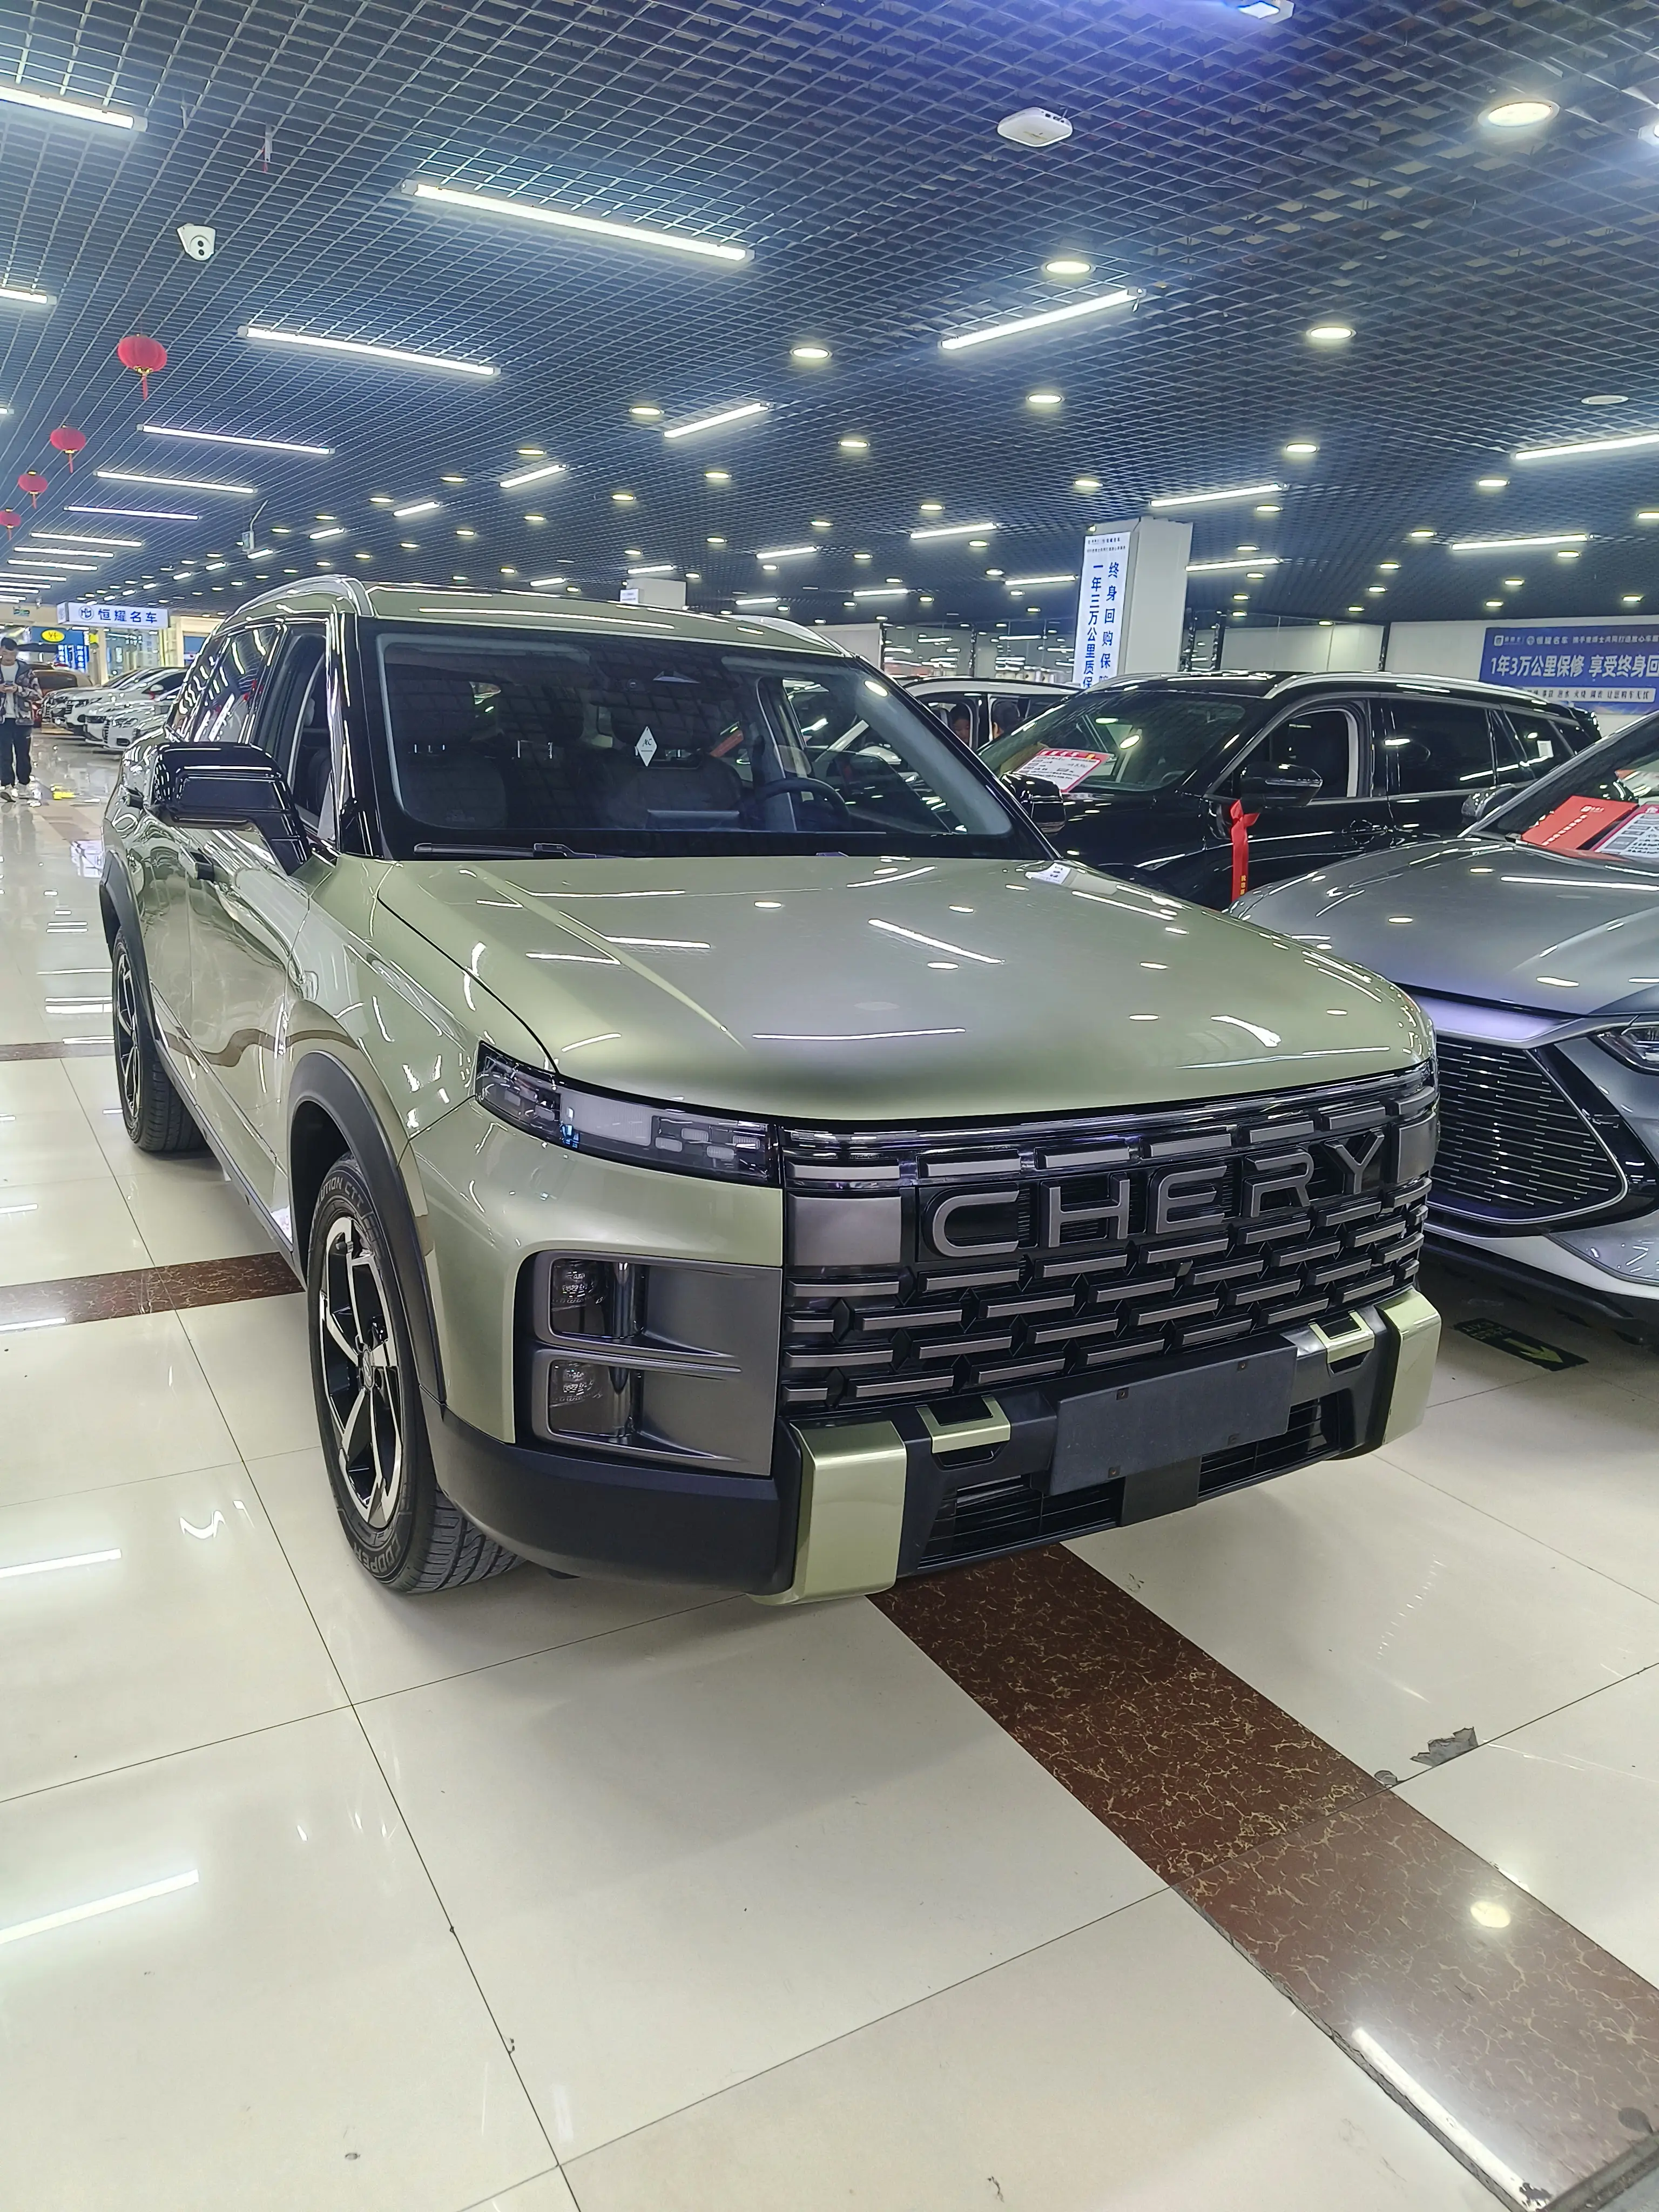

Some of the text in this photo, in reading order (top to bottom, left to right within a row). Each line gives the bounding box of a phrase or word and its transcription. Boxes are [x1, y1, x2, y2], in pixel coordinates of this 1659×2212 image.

[98, 608, 158, 624] 恒耀名车
[1099, 562, 1119, 682] 终身回购保
[1491, 654, 1585, 677] 1年3万公里保修
[926, 1128, 1385, 1258] CHERY
[353, 1533, 401, 1573] COOPER
